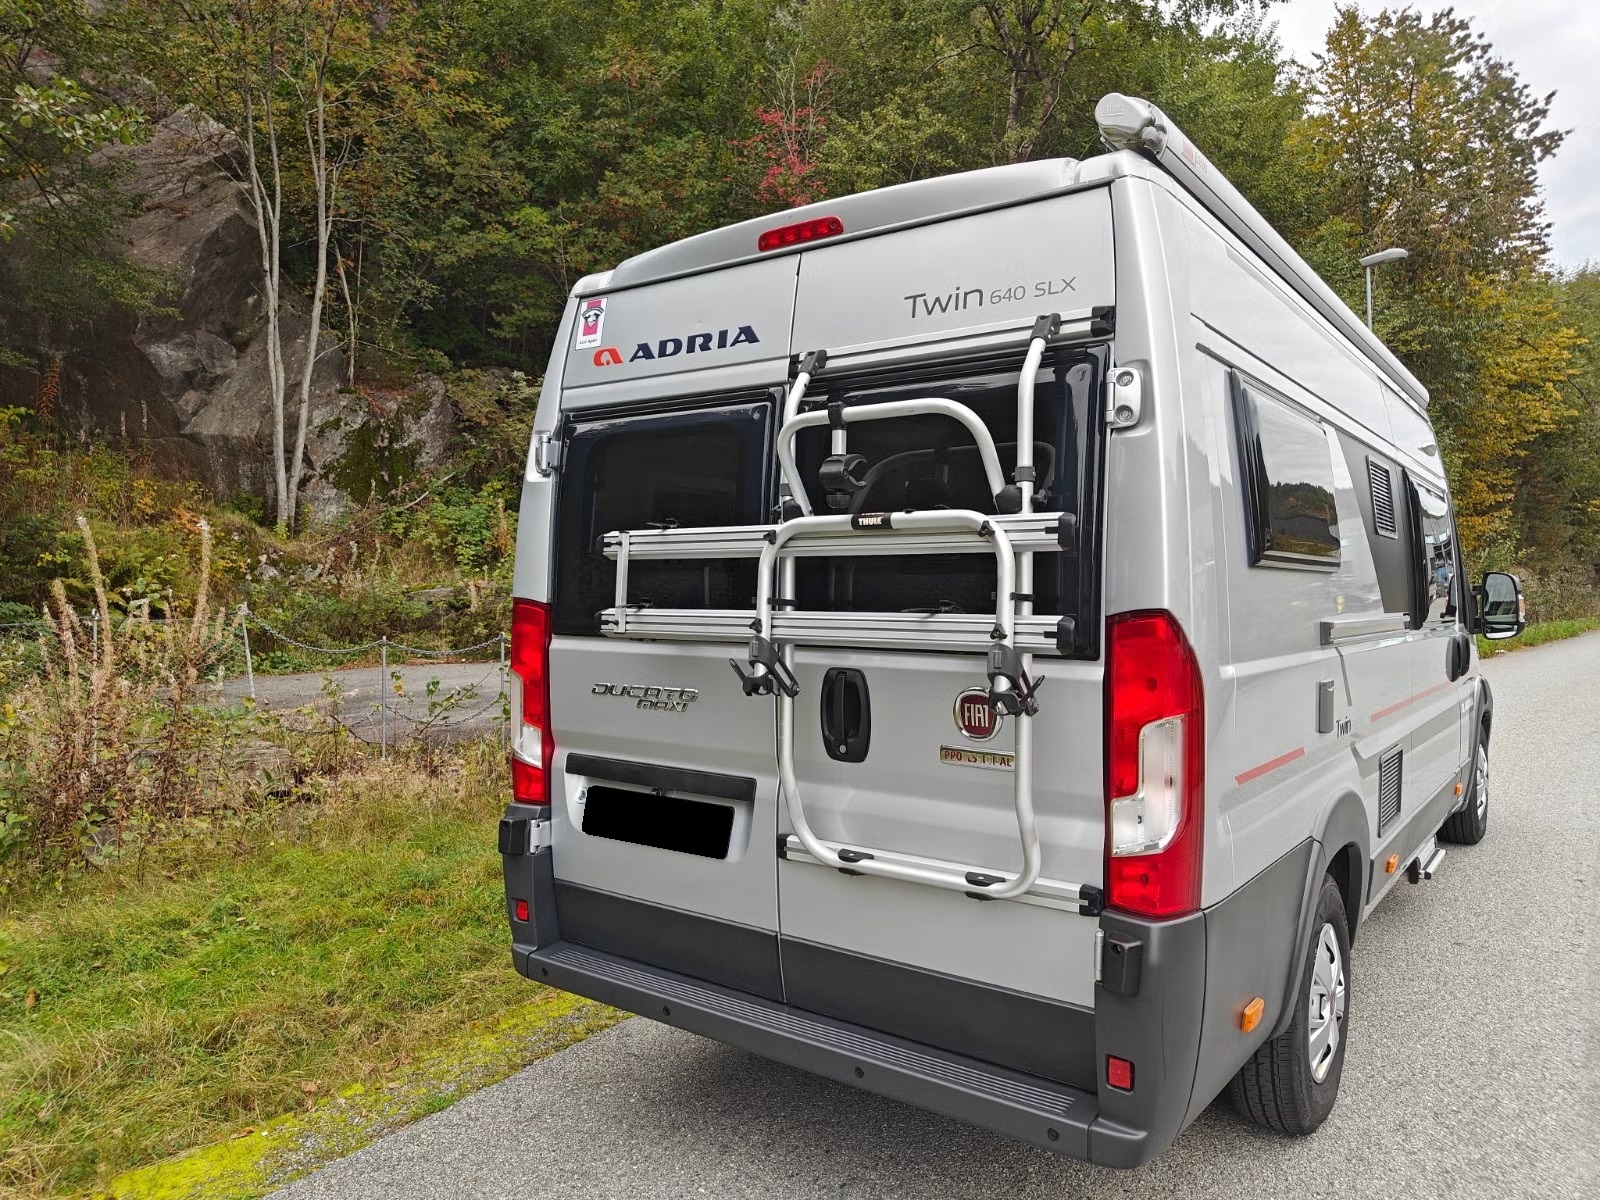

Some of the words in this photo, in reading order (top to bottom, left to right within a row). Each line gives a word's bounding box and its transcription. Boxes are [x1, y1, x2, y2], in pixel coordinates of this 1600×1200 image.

[904, 286, 984, 319] Twin
[989, 285, 1026, 305] 640
[1034, 276, 1077, 298] SLX
[629, 325, 760, 363] ADRIA
[858, 517, 882, 526] THULE
[591, 682, 699, 702] DUCATO
[964, 703, 989, 727] FIAT
[1335, 715, 1352, 739] Twin
[944, 750, 1012, 767] PROESINAL
